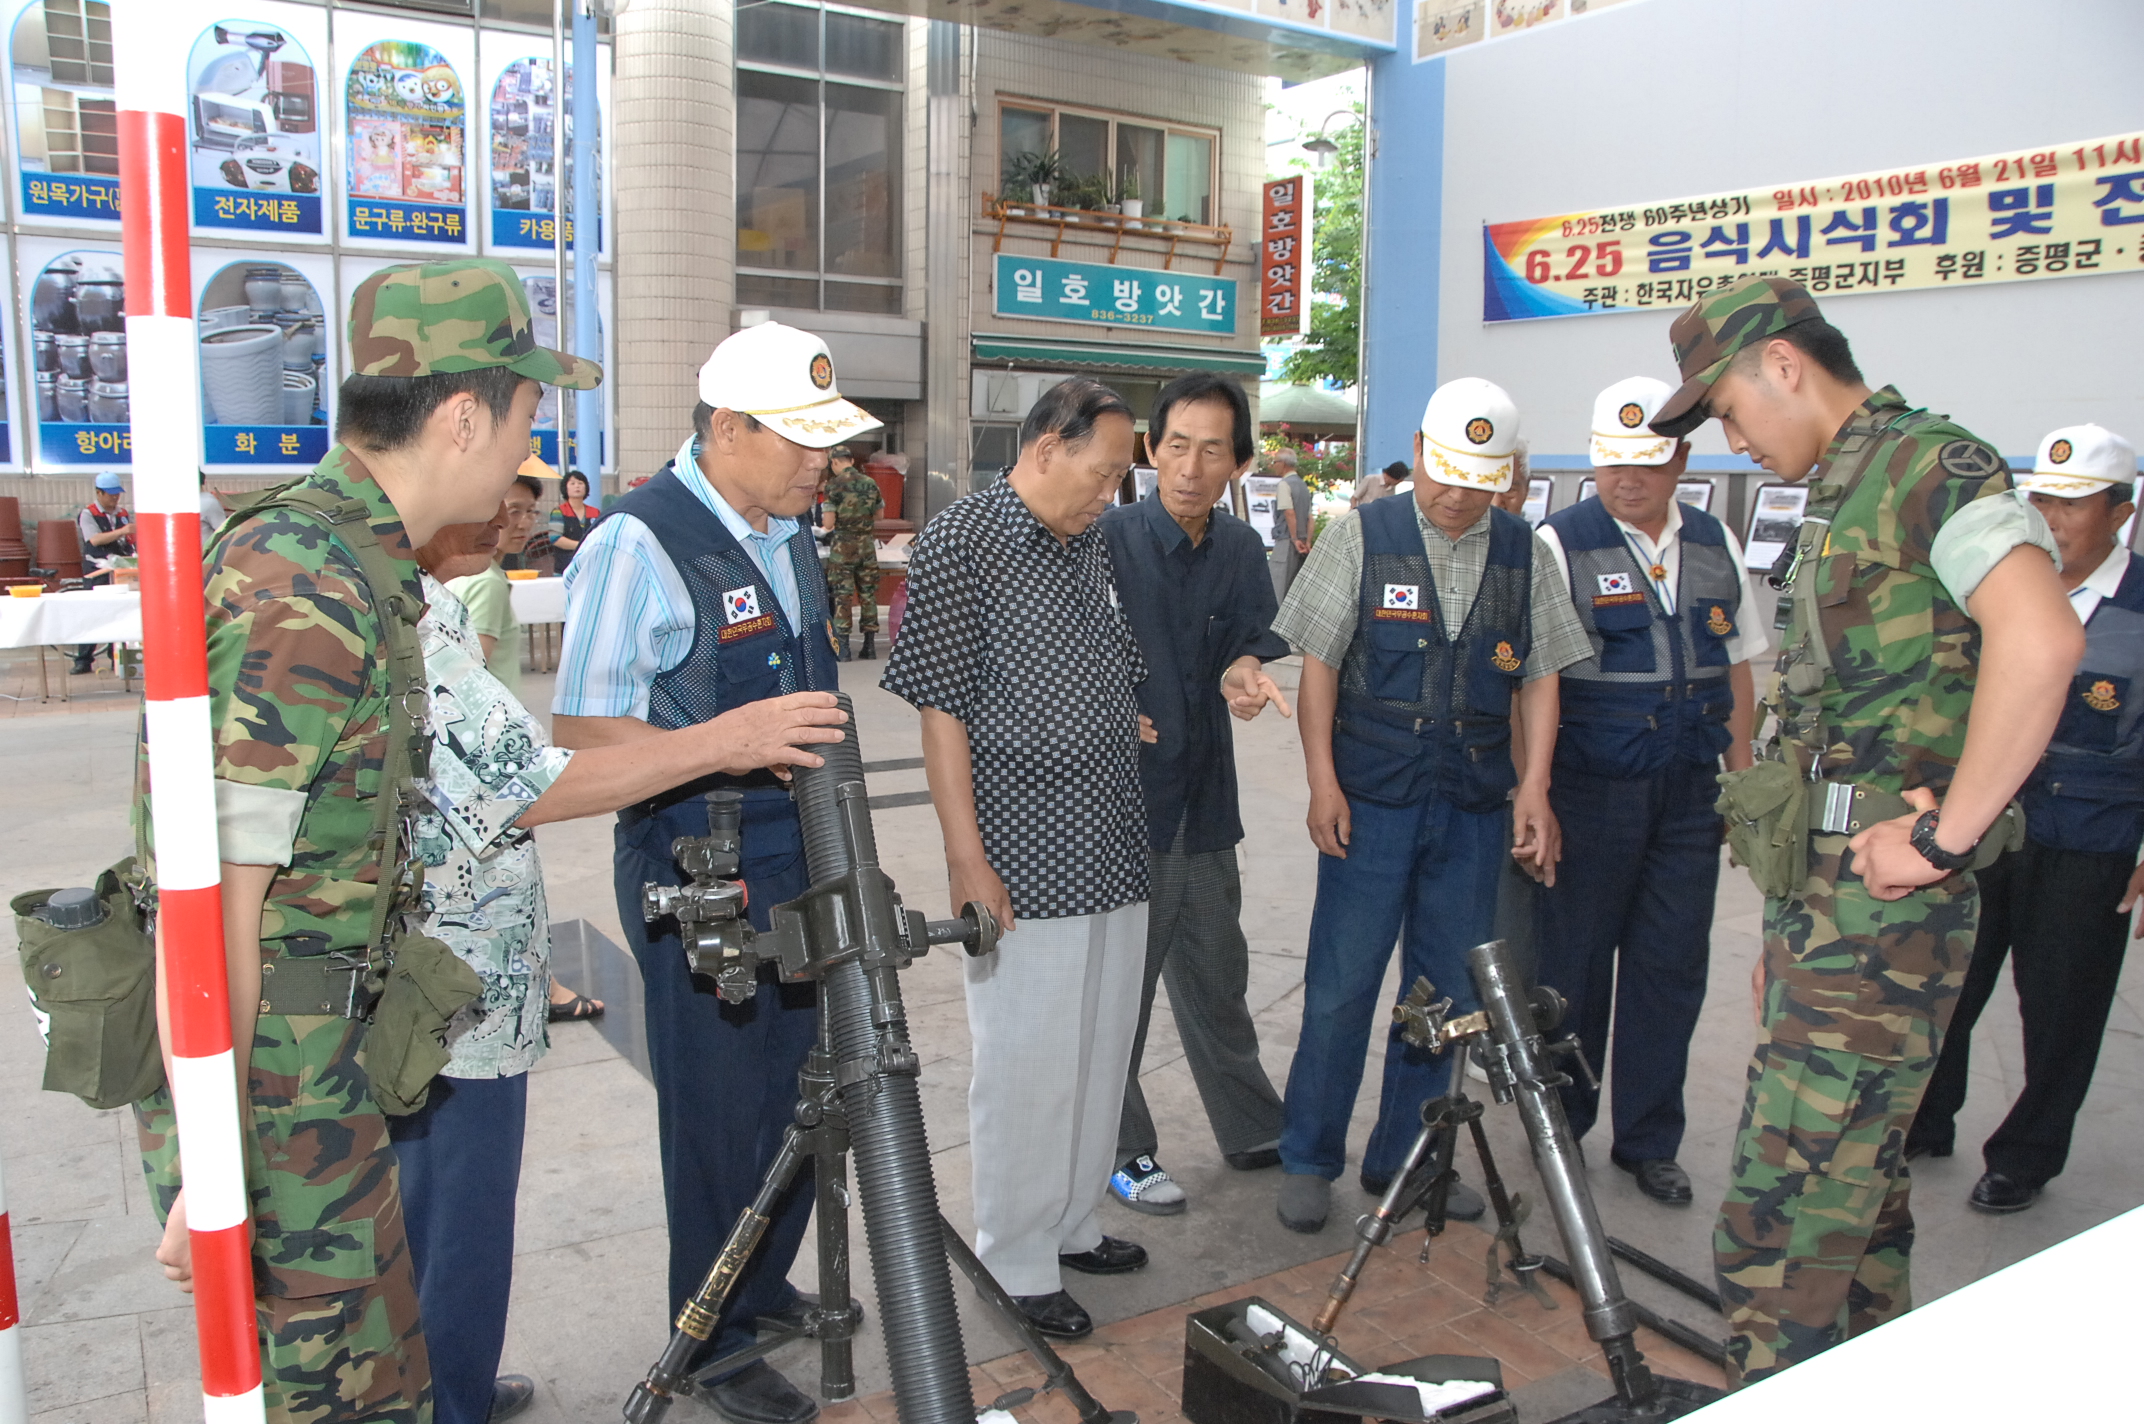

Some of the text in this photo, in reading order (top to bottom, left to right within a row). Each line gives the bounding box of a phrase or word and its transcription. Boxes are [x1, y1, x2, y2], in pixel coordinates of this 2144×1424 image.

[214, 196, 301, 223] 전자제품
[1772, 186, 1819, 212] 일시
[1840, 170, 1929, 203] 2010년
[1938, 162, 1983, 190] 6월
[1993, 151, 2059, 182] 21일
[2071, 137, 2142, 170] 11시
[1267, 181, 1297, 315] 일호방앗간
[1525, 240, 1624, 285] 6.25
[1646, 196, 1950, 274] 음식시식회
[1988, 183, 2056, 241] 및
[1562, 195, 1751, 238] 6.25전쟁 60주년상기
[1583, 286, 1617, 310] 주관
[1935, 250, 1986, 280] 후원
[2016, 238, 2102, 274] 증평군
[1091, 309, 1154, 324] 836-3237
